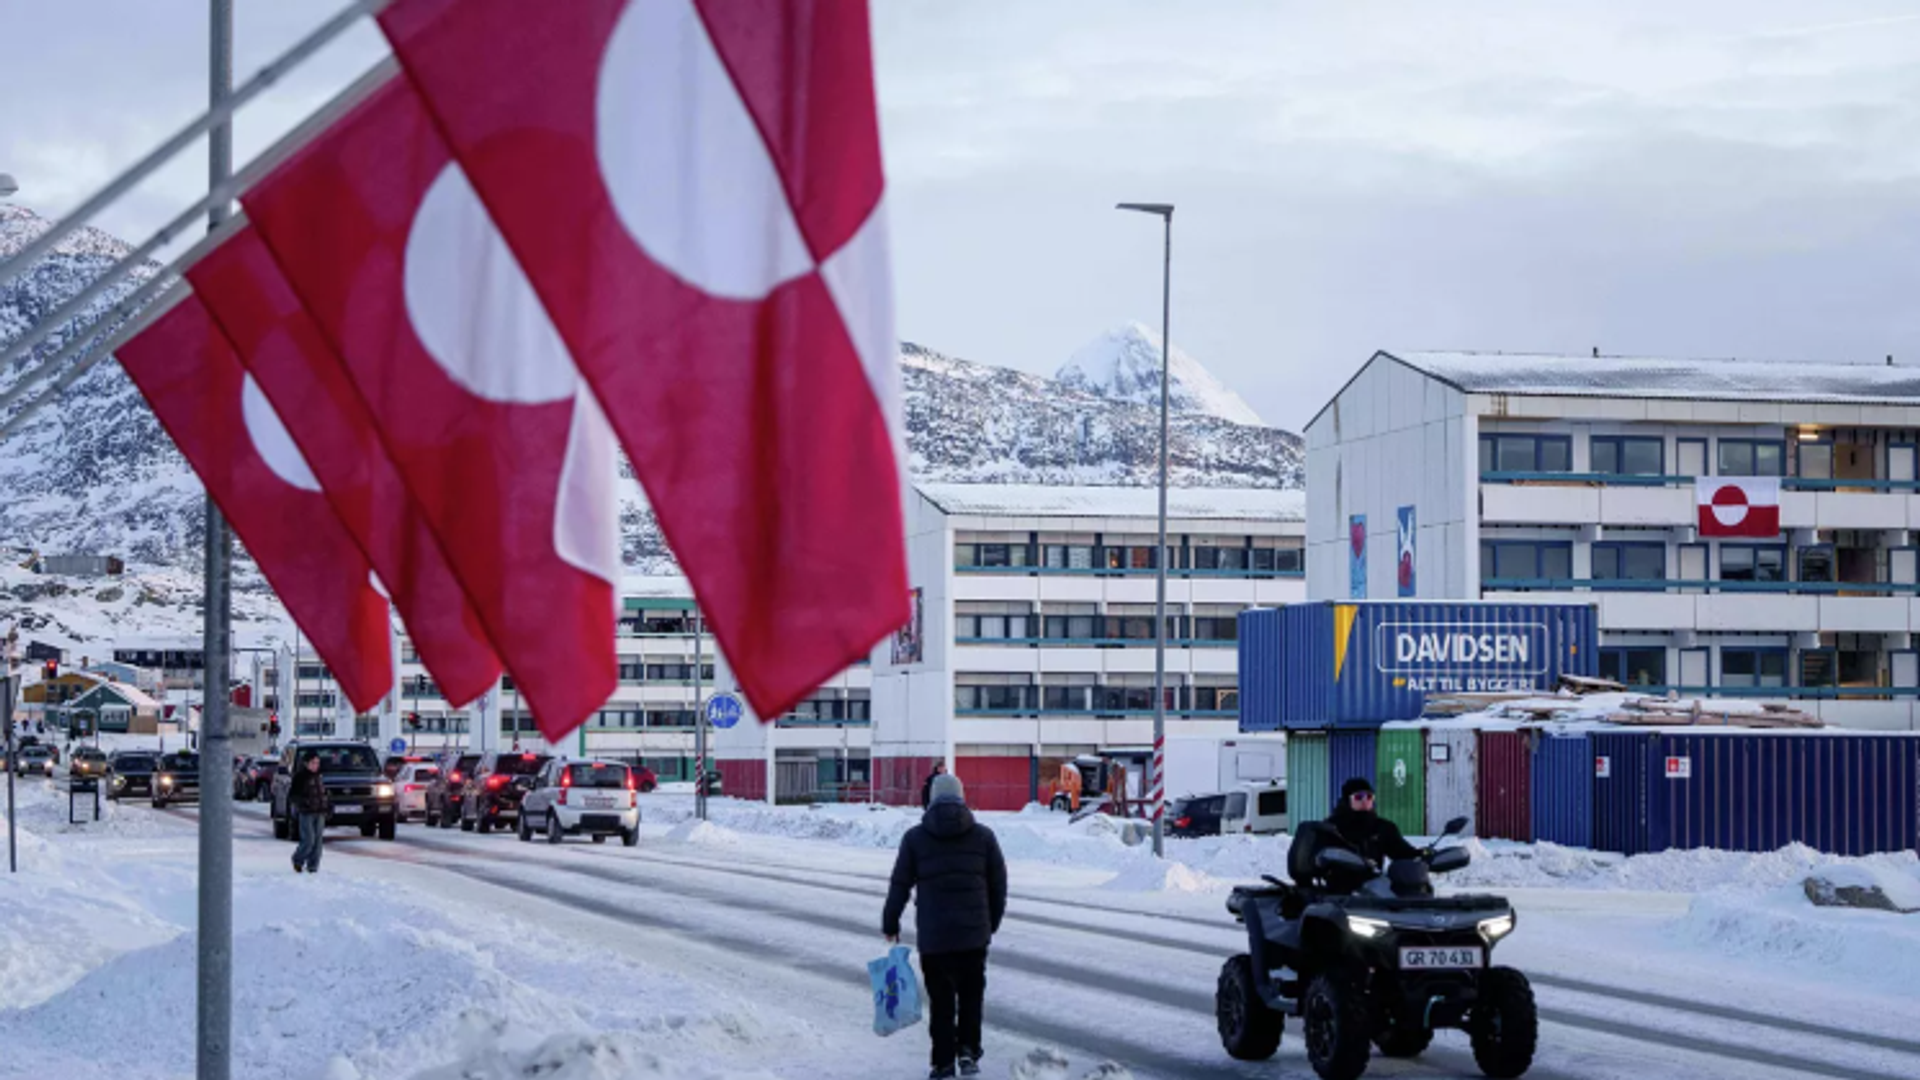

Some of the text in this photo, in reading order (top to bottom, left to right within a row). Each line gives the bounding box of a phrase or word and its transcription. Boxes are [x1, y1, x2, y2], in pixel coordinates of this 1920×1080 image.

[1397, 634, 1529, 663] DAVIDSEN
[1407, 677, 1435, 691] ALT
[1438, 677, 1463, 691] TIL
[1405, 949, 1426, 966] GR
[1428, 949, 1448, 966] 70
